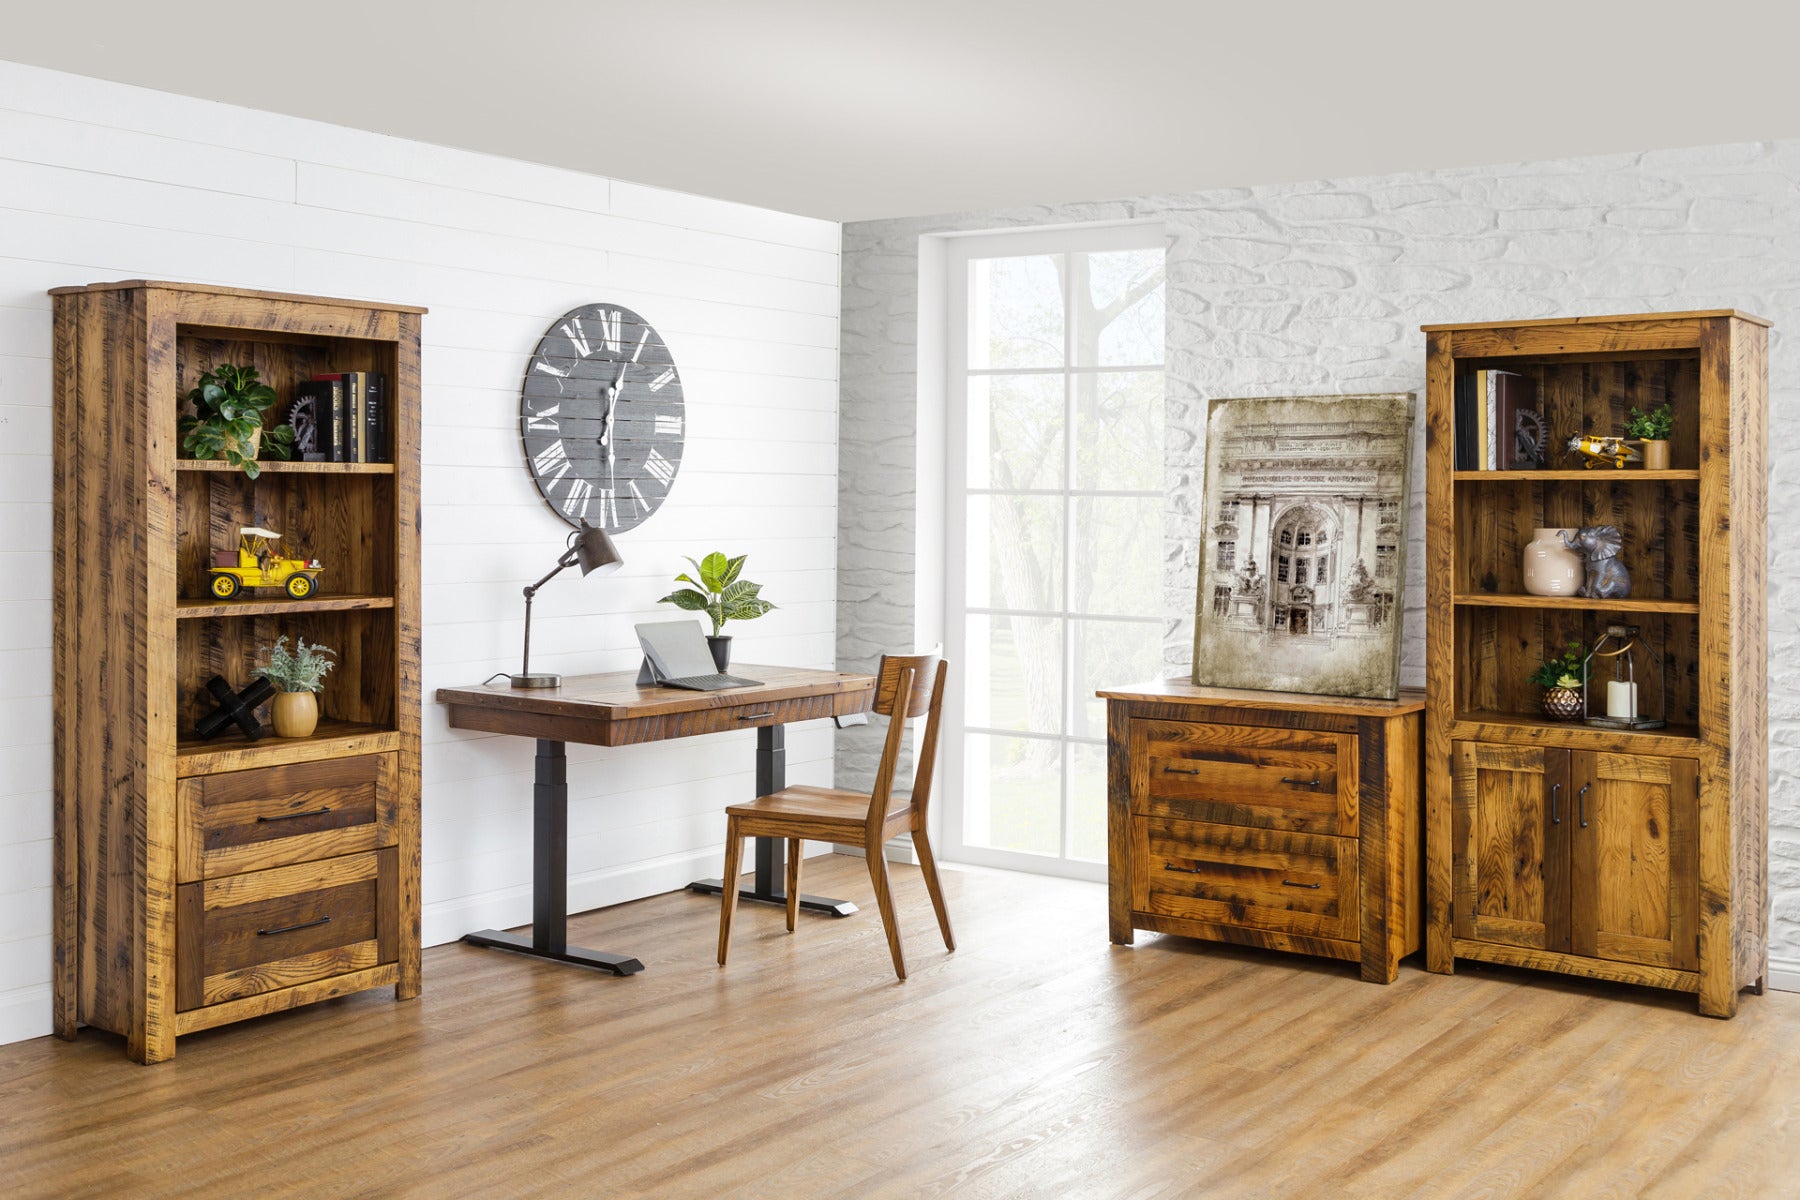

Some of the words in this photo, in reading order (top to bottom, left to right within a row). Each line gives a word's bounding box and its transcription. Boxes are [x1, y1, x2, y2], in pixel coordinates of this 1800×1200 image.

[560, 315, 593, 367] XI
[596, 309, 622, 353] XII
[631, 327, 650, 363] I
[648, 367, 676, 392] II
[655, 413, 682, 435] III
[533, 438, 572, 495] VIII
[599, 488, 621, 528] VI
[627, 479, 653, 520] V
